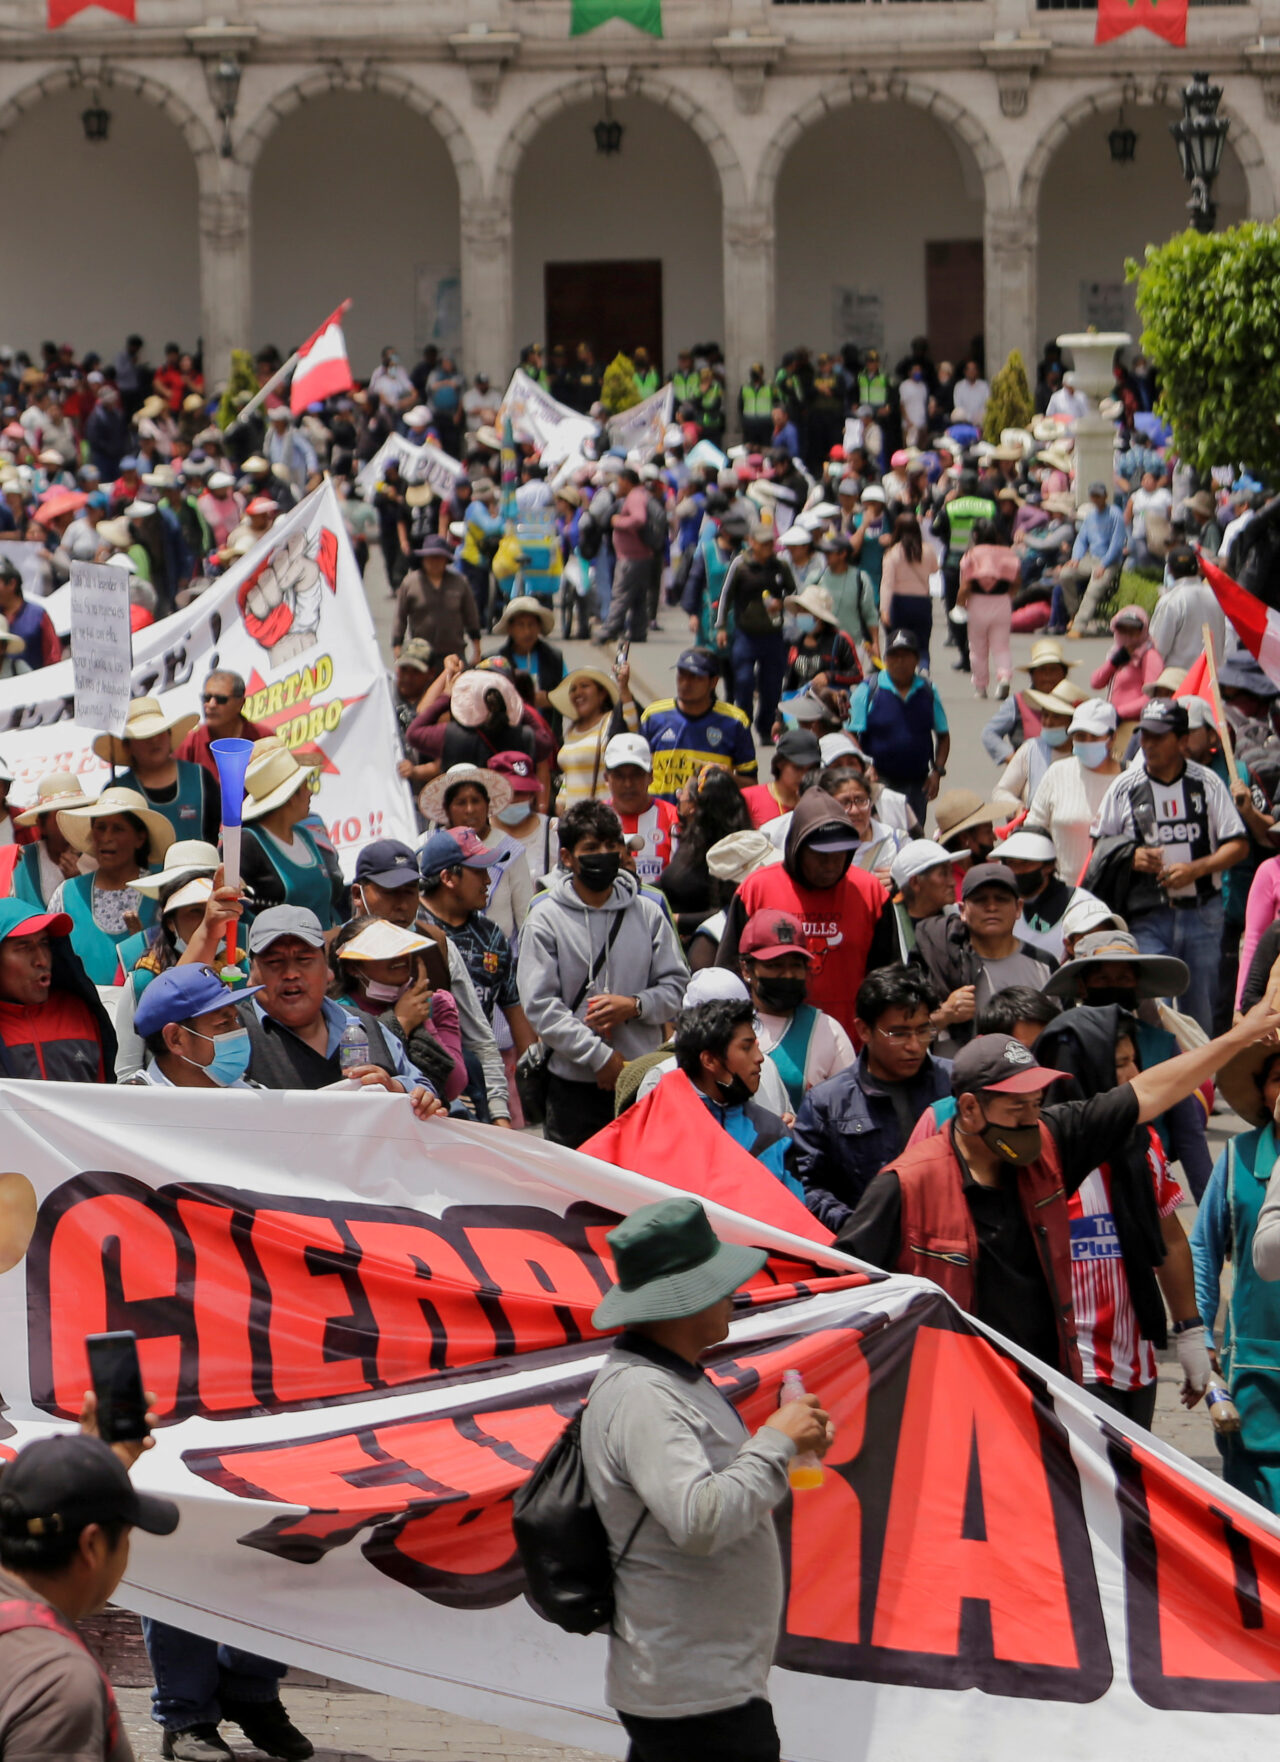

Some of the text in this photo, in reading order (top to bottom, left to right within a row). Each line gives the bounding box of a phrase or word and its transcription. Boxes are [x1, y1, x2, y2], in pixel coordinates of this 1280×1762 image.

[275, 697, 345, 751] EDRO
[1144, 822, 1200, 845] Jeep
[802, 922, 838, 936] ULLS
[26, 1170, 670, 1425] CIERR
